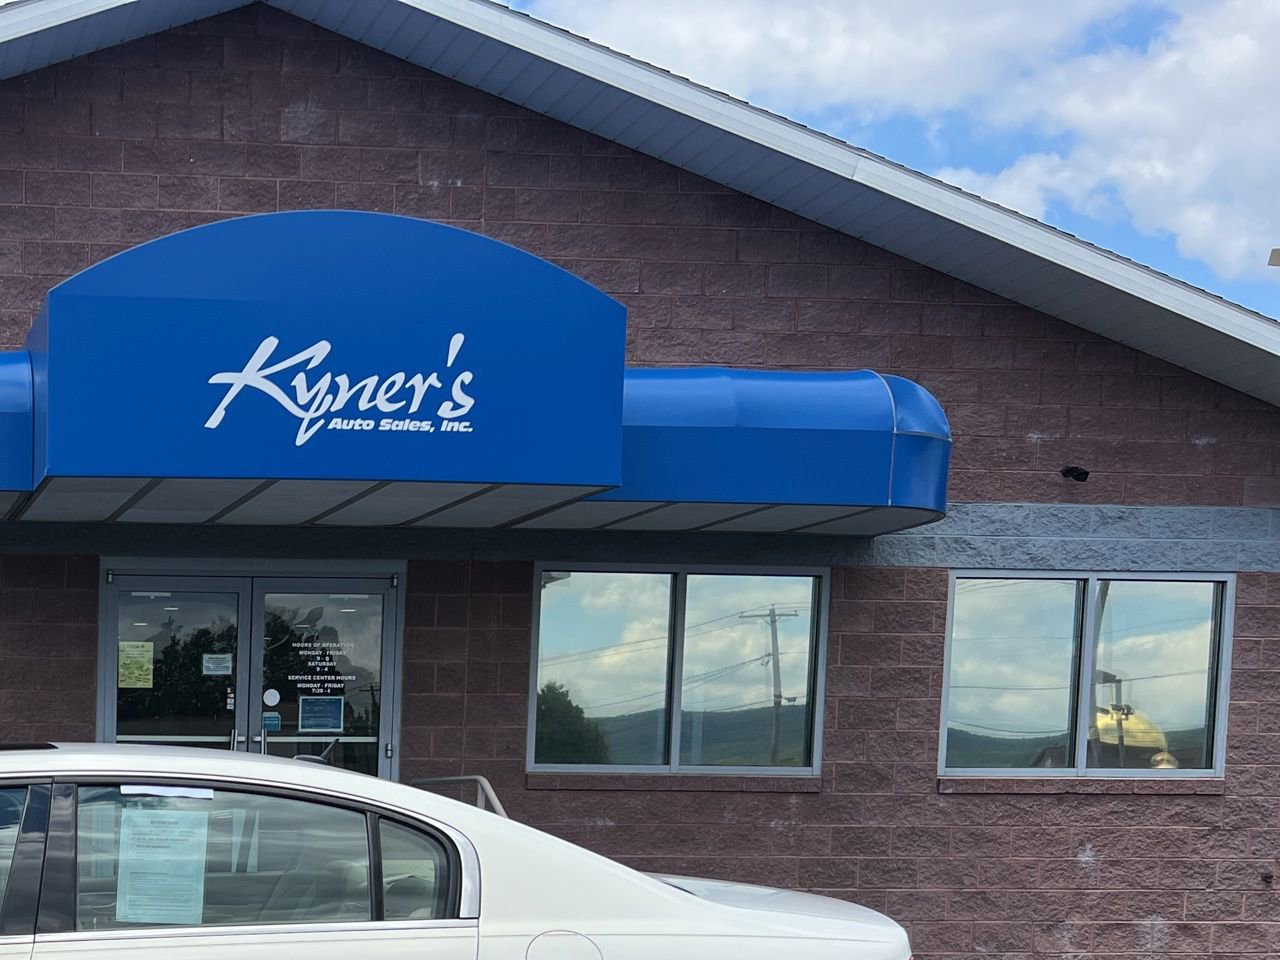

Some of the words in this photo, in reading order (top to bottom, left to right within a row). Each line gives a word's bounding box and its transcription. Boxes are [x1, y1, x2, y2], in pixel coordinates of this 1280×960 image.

[203, 332, 476, 447] Kyner's
[327, 417, 375, 431] Auto
[378, 418, 435, 433] Sales,
[439, 419, 474, 433] Inc.
